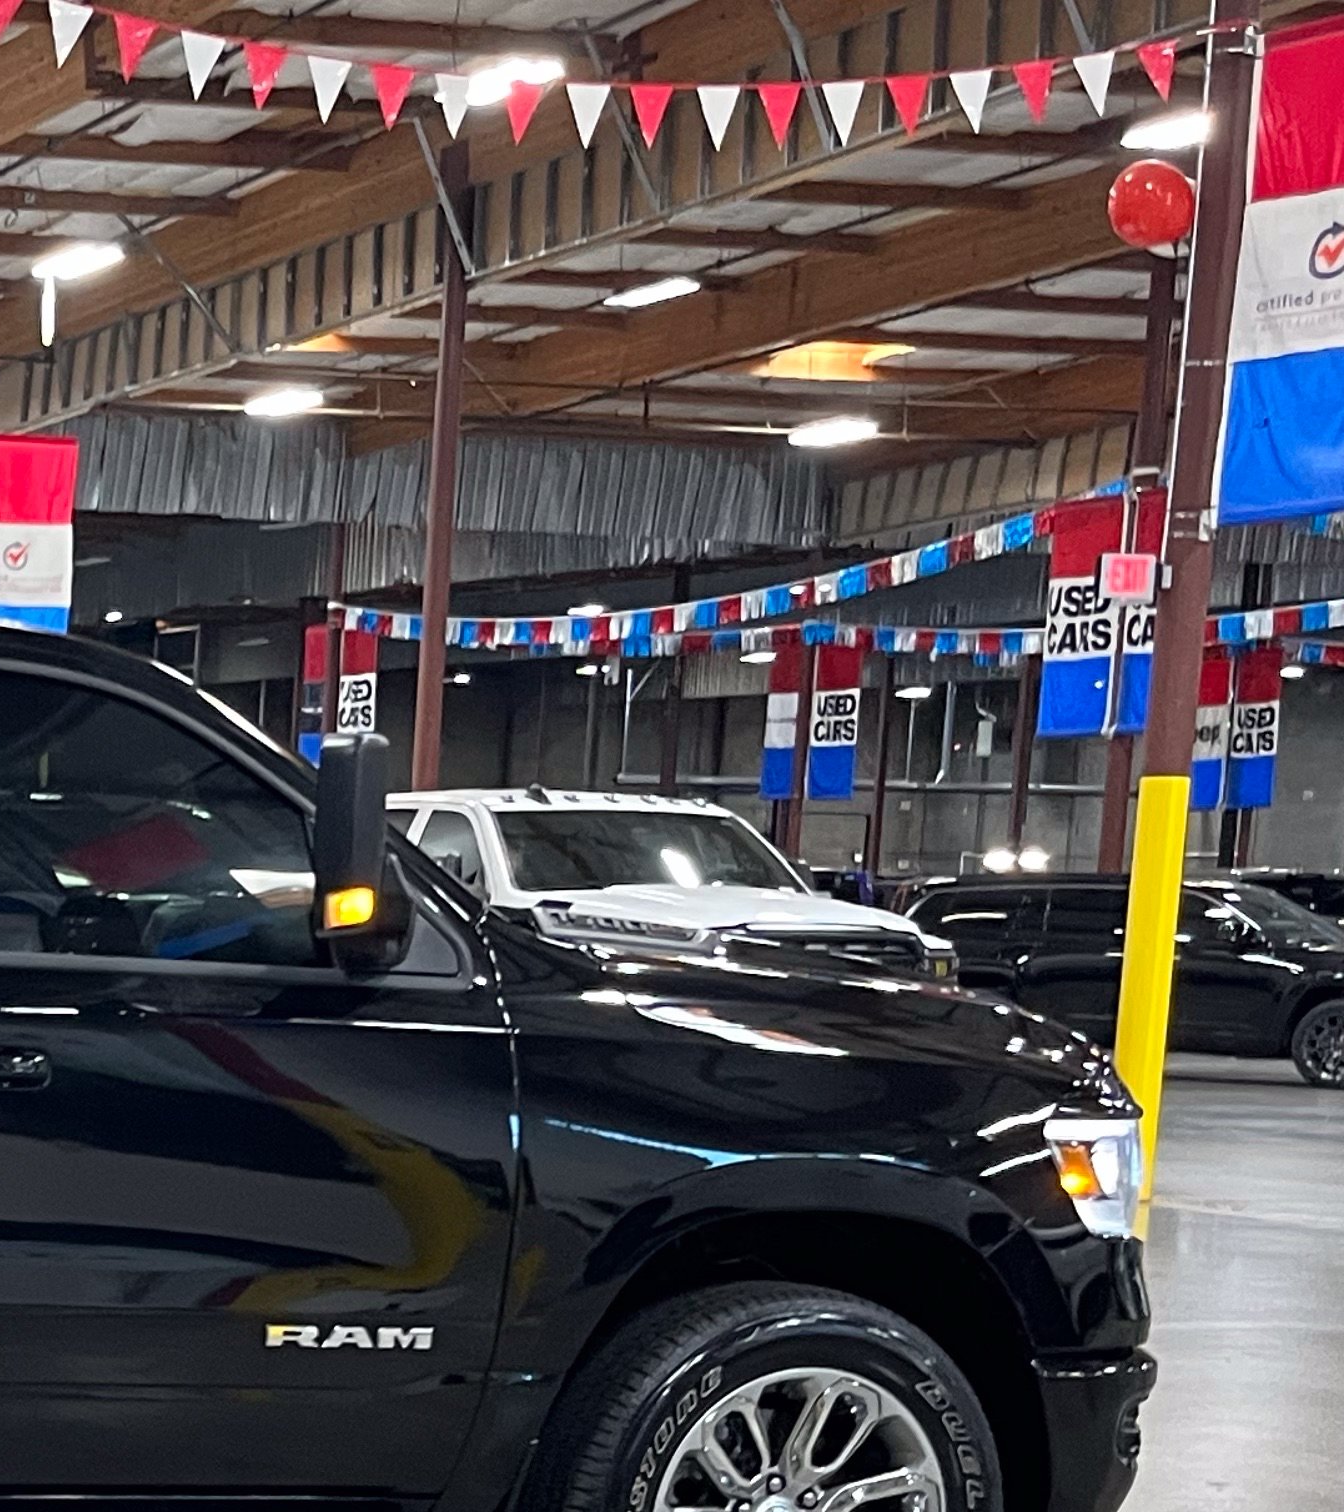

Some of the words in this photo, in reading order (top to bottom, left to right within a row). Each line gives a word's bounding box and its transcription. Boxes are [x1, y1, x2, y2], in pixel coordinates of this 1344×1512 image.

[1110, 558, 1149, 593] EXIT
[1048, 585, 1113, 617] USED
[1047, 618, 1112, 655] CARS
[339, 679, 372, 702] UED
[339, 704, 372, 728] CS
[817, 693, 857, 717] USED
[265, 1324, 434, 1350] RAM
